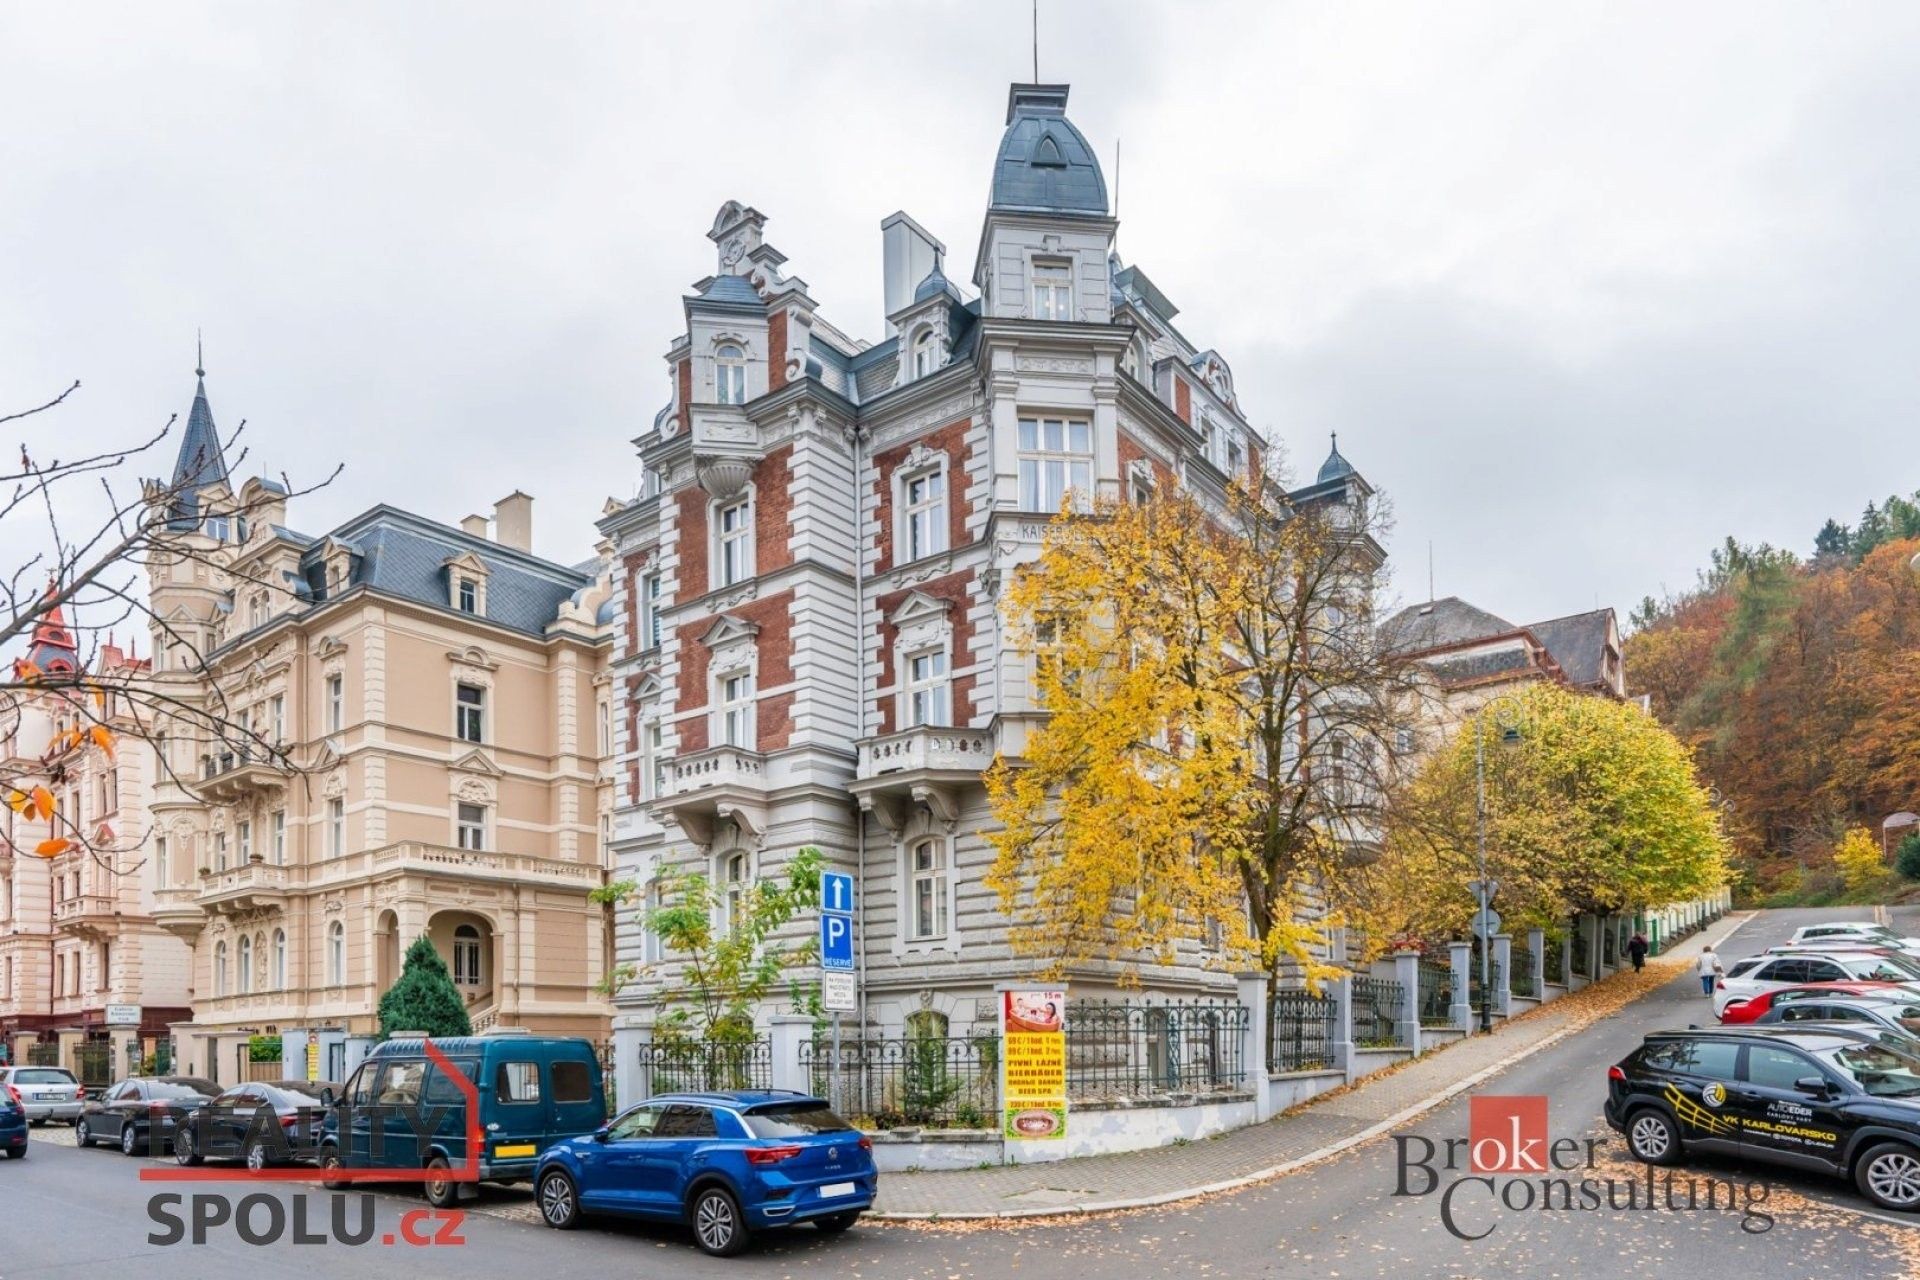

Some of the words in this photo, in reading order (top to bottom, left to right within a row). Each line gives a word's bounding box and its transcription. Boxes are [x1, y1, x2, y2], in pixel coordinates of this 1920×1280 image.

[828, 917, 845, 948] P
[1722, 1114, 1739, 1125] VK
[1743, 1119, 1837, 1141] KARLOVARSKO
